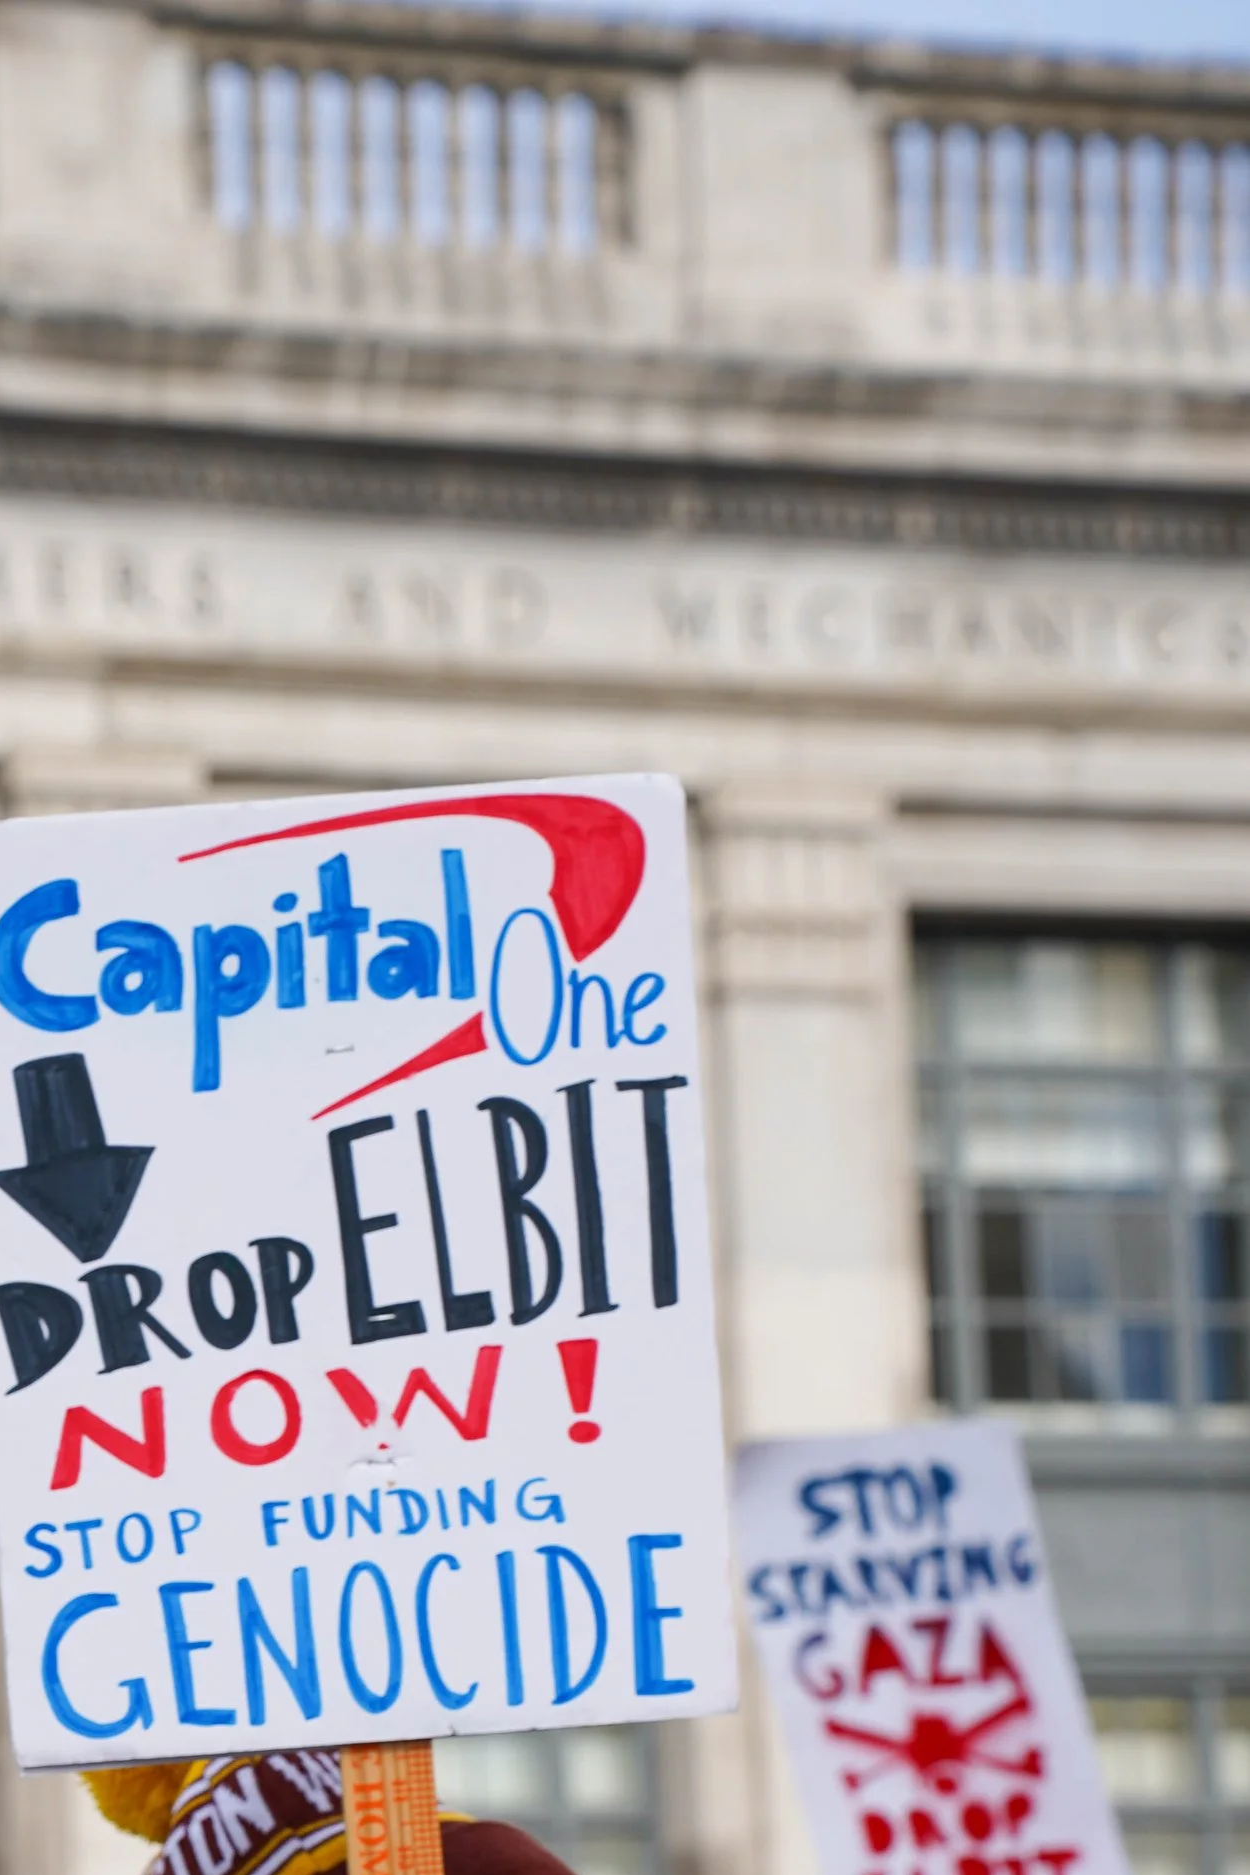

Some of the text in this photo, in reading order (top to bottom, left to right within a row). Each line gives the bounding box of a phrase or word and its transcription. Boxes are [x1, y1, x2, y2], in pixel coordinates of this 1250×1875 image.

[325, 558, 548, 652] AND
[490, 908, 667, 1066] One
[329, 1076, 688, 1344] ELBIT
[24, 1477, 566, 1578] STOP FUNDING
[799, 1461, 957, 1538] STOP
[748, 1535, 1037, 1622] STARVING
[41, 1533, 695, 1739] GENOCIDE
[794, 1618, 1026, 1700] GAZA
[862, 1792, 1033, 1856] DROP
